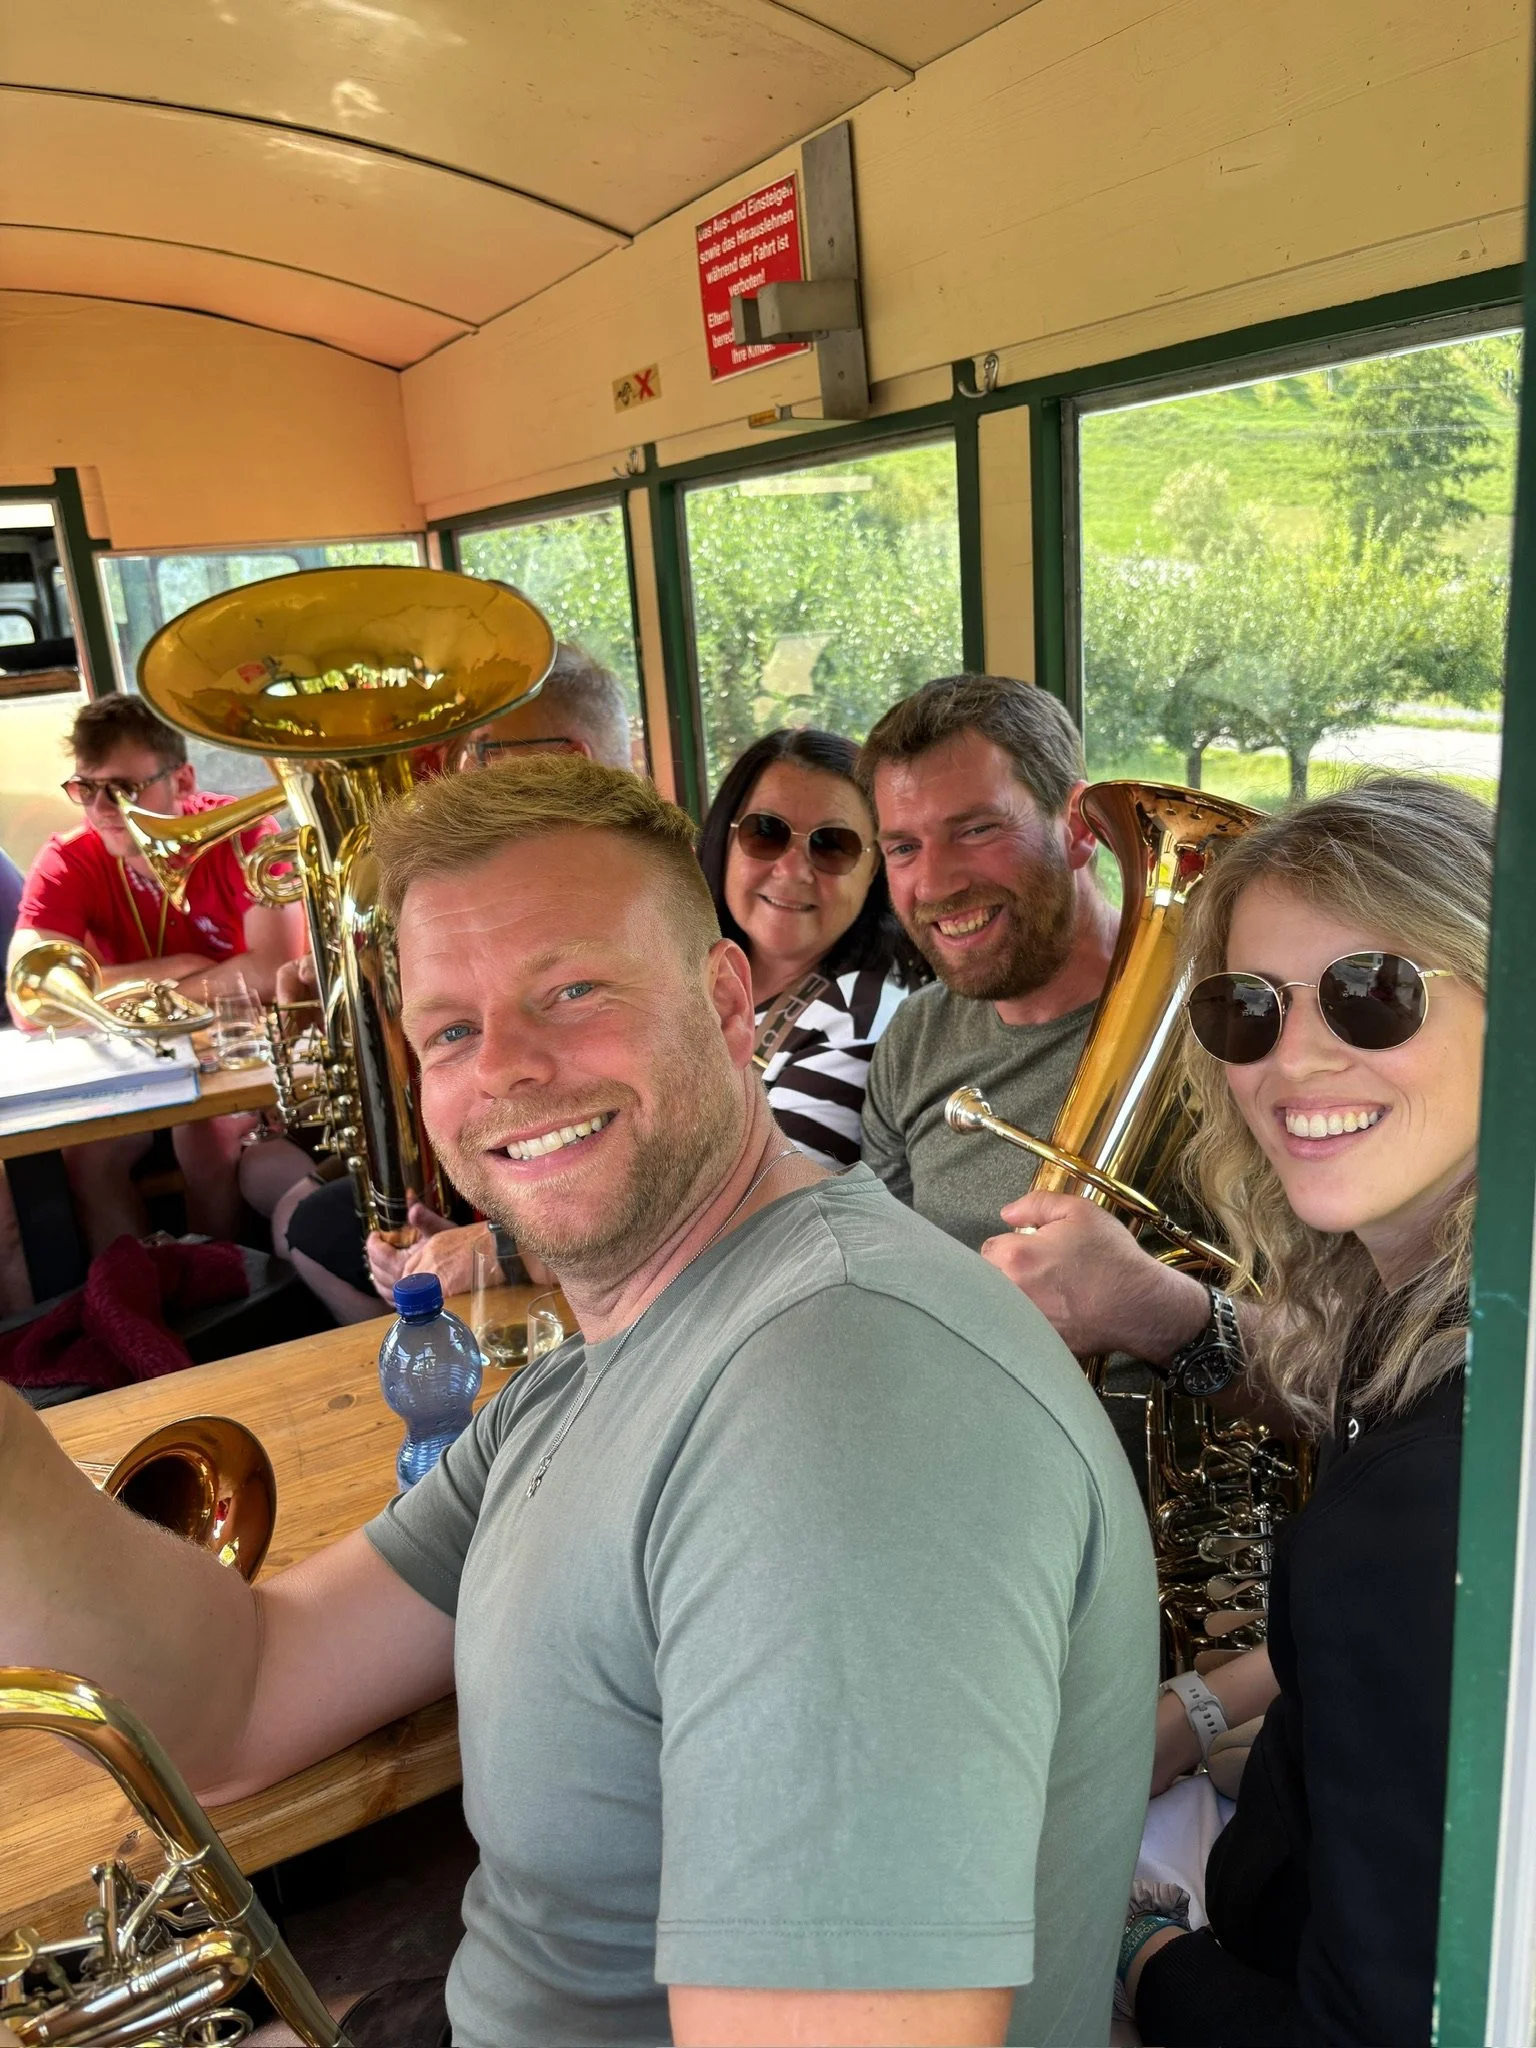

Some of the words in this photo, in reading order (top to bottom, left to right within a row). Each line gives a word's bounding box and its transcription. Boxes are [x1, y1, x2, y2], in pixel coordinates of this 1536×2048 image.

[712, 217, 731, 235] Aus-
[731, 203, 747, 225] und
[700, 242, 722, 265] sowie
[721, 237, 737, 255] das
[736, 209, 795, 246] Hinauslehnen
[705, 256, 740, 285] während
[739, 253, 753, 270] der
[752, 239, 778, 263] Fahrt
[777, 233, 791, 253] ist
[728, 267, 767, 298] verboten!
[707, 310, 731, 329] Eltern
[731, 348, 748, 364] Ihre
